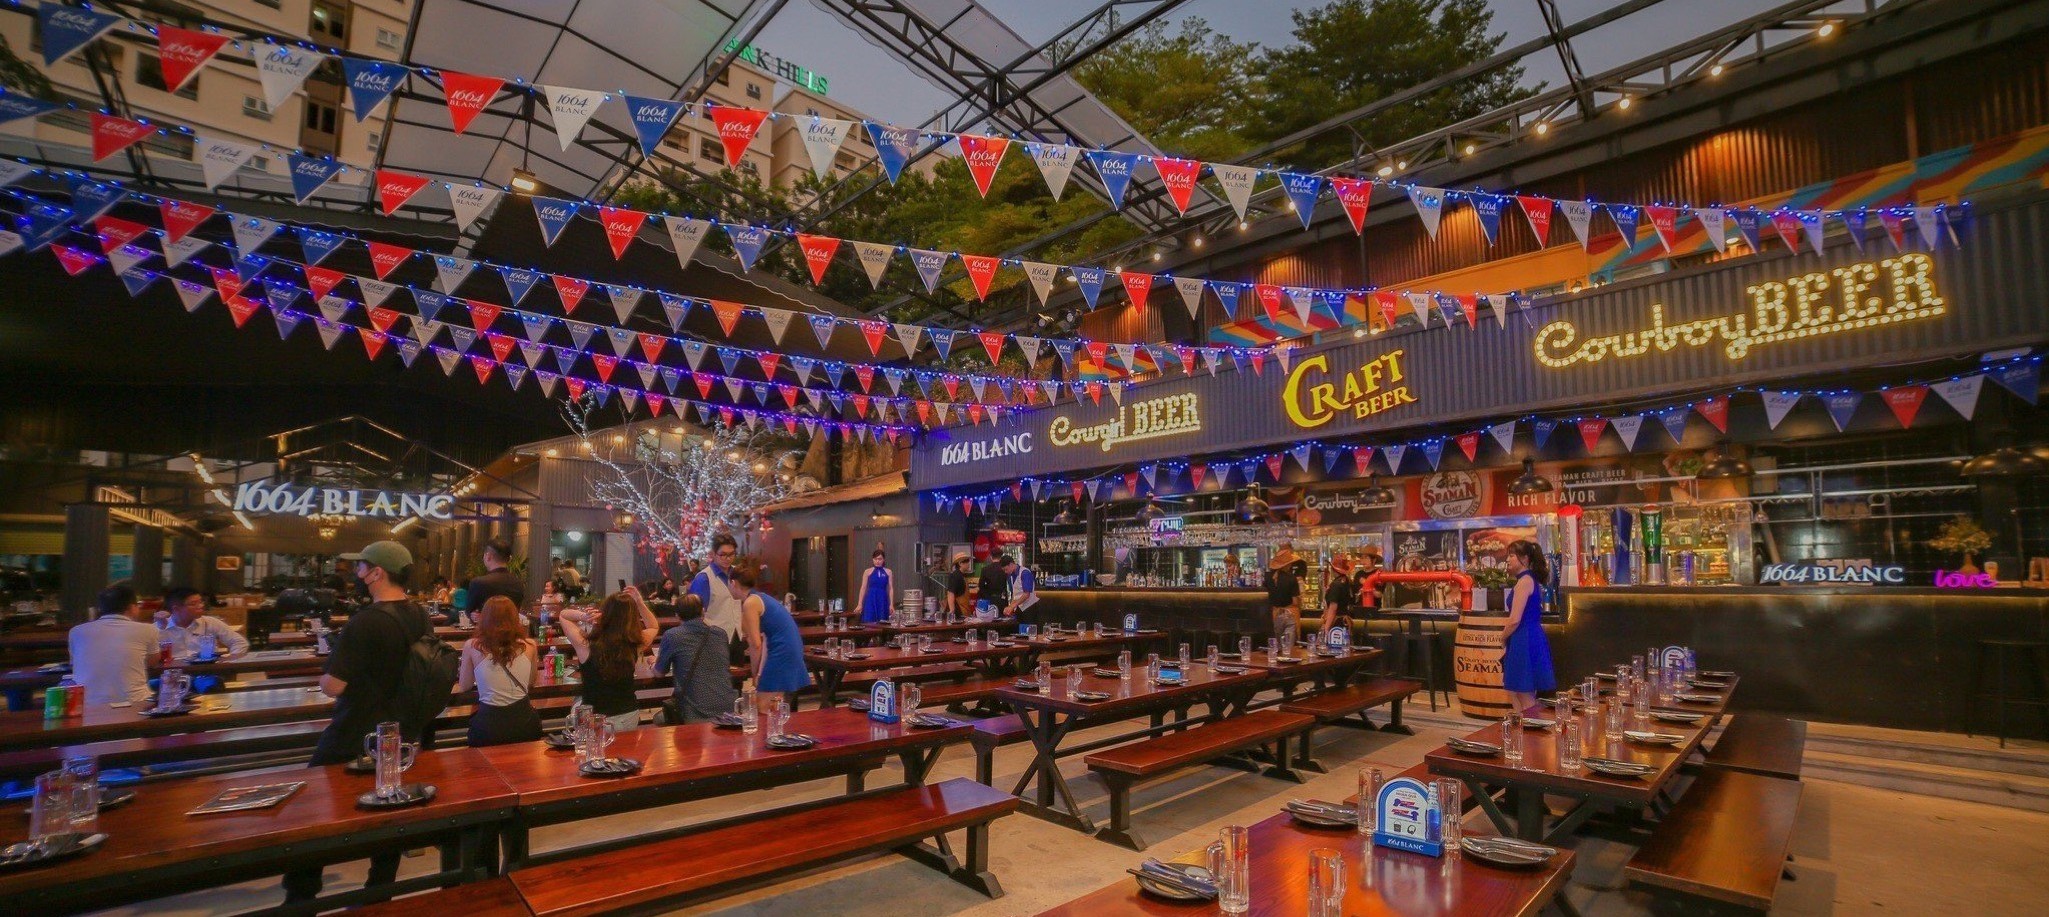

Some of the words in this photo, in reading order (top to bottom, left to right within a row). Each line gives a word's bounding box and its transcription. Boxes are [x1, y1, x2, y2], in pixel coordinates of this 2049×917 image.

[356, 72, 391, 85] 1664
[776, 57, 828, 96] HILLS
[354, 81, 390, 92] BLANC
[451, 90, 484, 102] 1664
[557, 94, 588, 107] 1664
[450, 100, 483, 109] BLANC
[555, 105, 587, 115] BLANC
[637, 106, 668, 117] 1664
[636, 115, 667, 124] BLANC
[722, 122, 751, 132] 1664
[808, 123, 836, 135] 1664
[721, 131, 752, 139] BLANC
[808, 135, 836, 145] BLANC
[880, 130, 907, 141] 1664
[880, 140, 908, 148] BLANC
[970, 150, 997, 160] 1664
[1042, 150, 1067, 160] 1664
[298, 162, 327, 173] 1664
[1102, 160, 1127, 169] 1664
[1167, 173, 1191, 183] 1664
[1225, 171, 1248, 181] 1664
[384, 184, 412, 194] 1664
[458, 190, 484, 201] 1664
[1344, 193, 1365, 202] 1664
[456, 199, 482, 207] BLANC
[541, 207, 566, 217] 1664
[541, 214, 565, 222] BLANC
[609, 222, 632, 233] 1664
[675, 224, 696, 234] 1664
[738, 232, 759, 241] 1664
[807, 248, 828, 258] 1664
[864, 248, 883, 257] 1664
[920, 257, 939, 265] 1664
[972, 260, 990, 269] 1664
[1032, 267, 1049, 276] 1664
[1082, 272, 1098, 281] 1664
[1535, 304, 1746, 366] Cowboy
[1747, 254, 1945, 336] BEER
[1282, 349, 1404, 428] CRAFT
[1354, 386, 1418, 419] BEER
[1050, 406, 1126, 451] Cowgirl
[1132, 392, 1200, 435] BEER
[941, 441, 970, 465] 1664
[972, 432, 1032, 461] BLANC
[1581, 471, 1604, 480] CRAFT
[1606, 469, 1626, 477] BEER
[233, 480, 317, 516] 1664
[322, 488, 455, 519] BLANC
[1424, 482, 1478, 507] SEAMAN
[1507, 494, 1538, 507] RICH
[1545, 490, 1597, 505] FLAVOR
[1304, 493, 1358, 513] Cowboy
[1763, 564, 1809, 583] 1664
[1812, 566, 1903, 583] BLANC
[1934, 569, 1996, 588] love
[1400, 840, 1424, 851] BLANC
